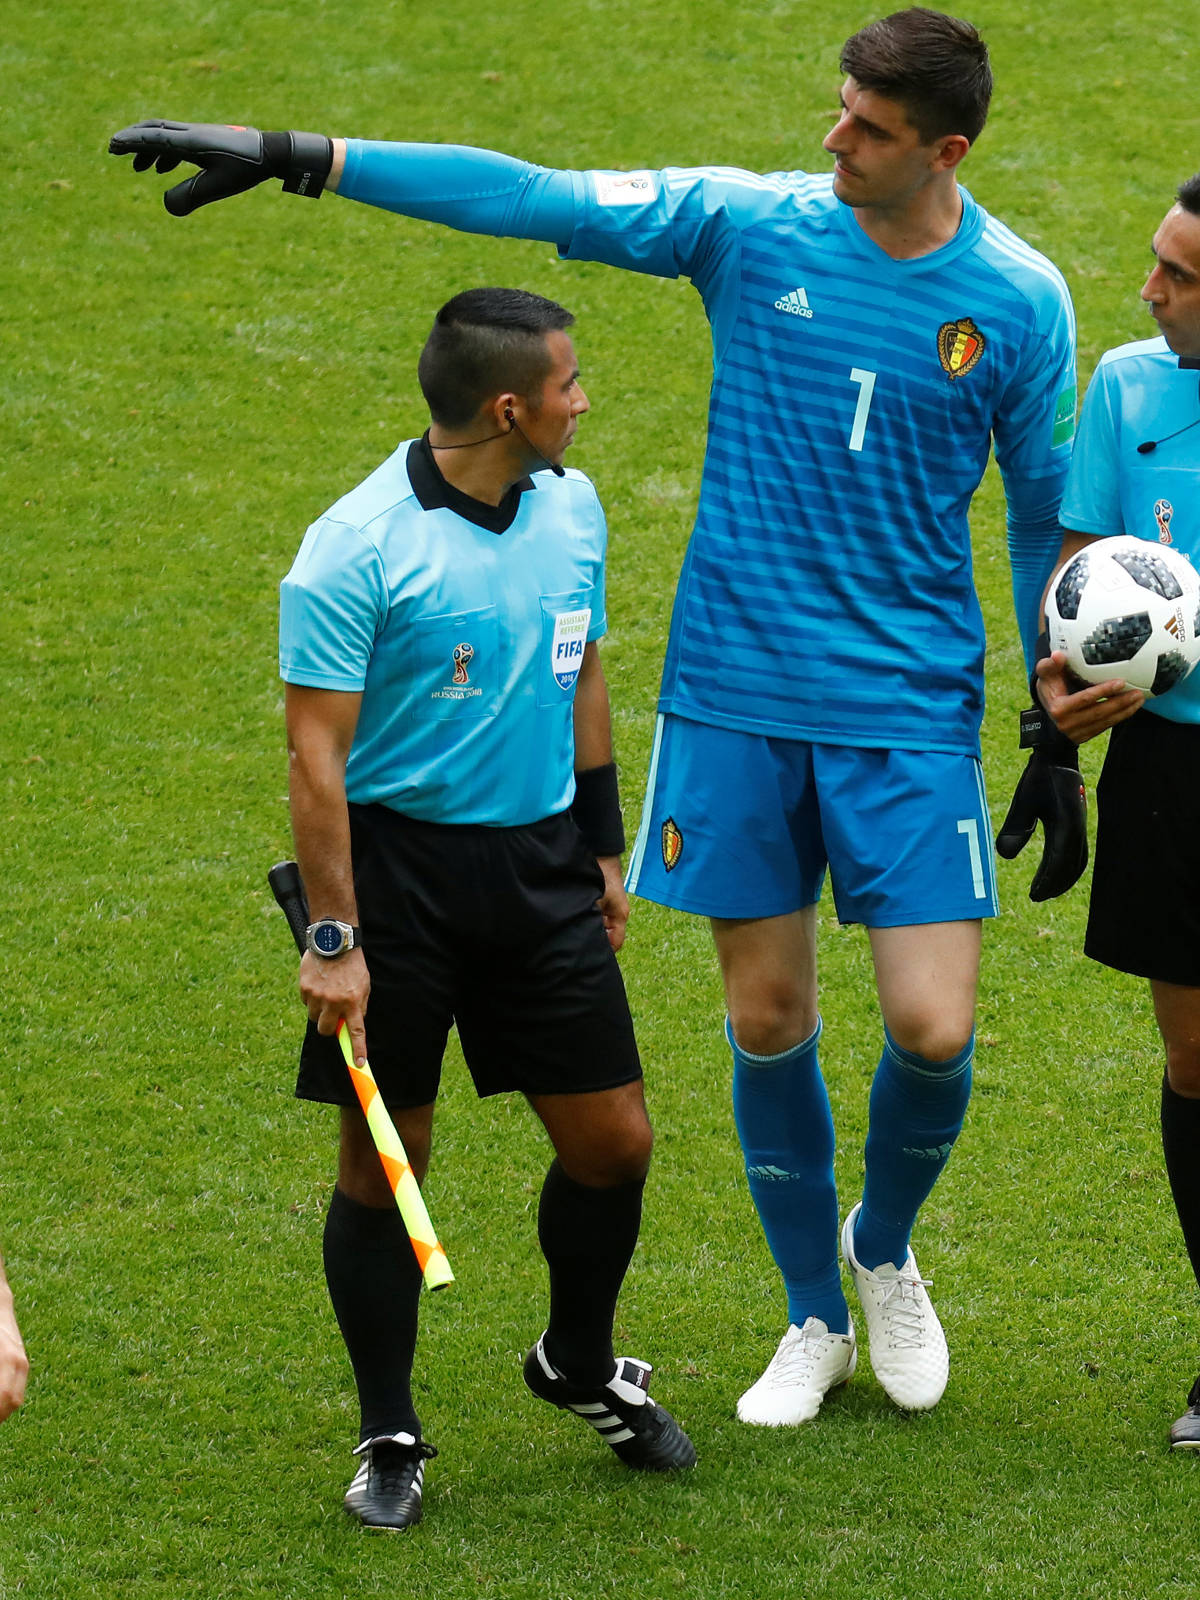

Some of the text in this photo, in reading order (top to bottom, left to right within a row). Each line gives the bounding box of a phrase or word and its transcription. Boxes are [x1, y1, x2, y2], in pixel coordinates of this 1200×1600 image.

[774, 299, 813, 319] adidas
[849, 367, 877, 452] 1
[559, 614, 588, 626] ASSISTANT
[1176, 606, 1186, 643] adidas
[556, 639, 582, 660] FIFA
[560, 673, 574, 684] 2018
[431, 690, 465, 700] RUSSIA
[957, 818, 987, 899] 1
